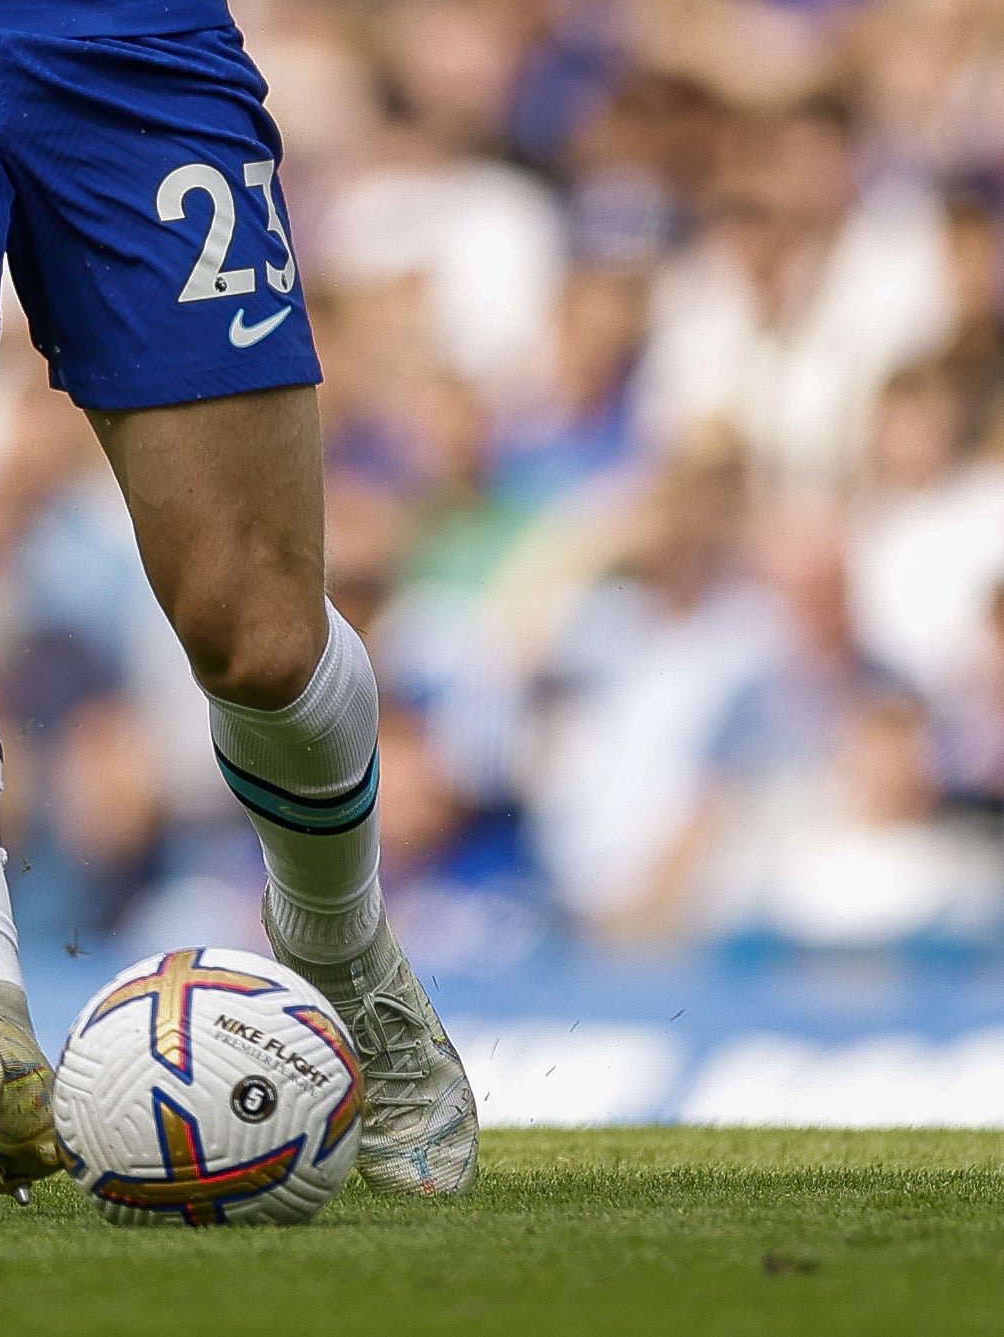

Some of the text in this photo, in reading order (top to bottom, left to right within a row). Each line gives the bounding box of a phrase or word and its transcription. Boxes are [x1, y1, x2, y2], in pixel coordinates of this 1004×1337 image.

[156, 159, 296, 303] 23
[214, 1014, 265, 1044] NIKE
[263, 1038, 329, 1087] FLIGHT
